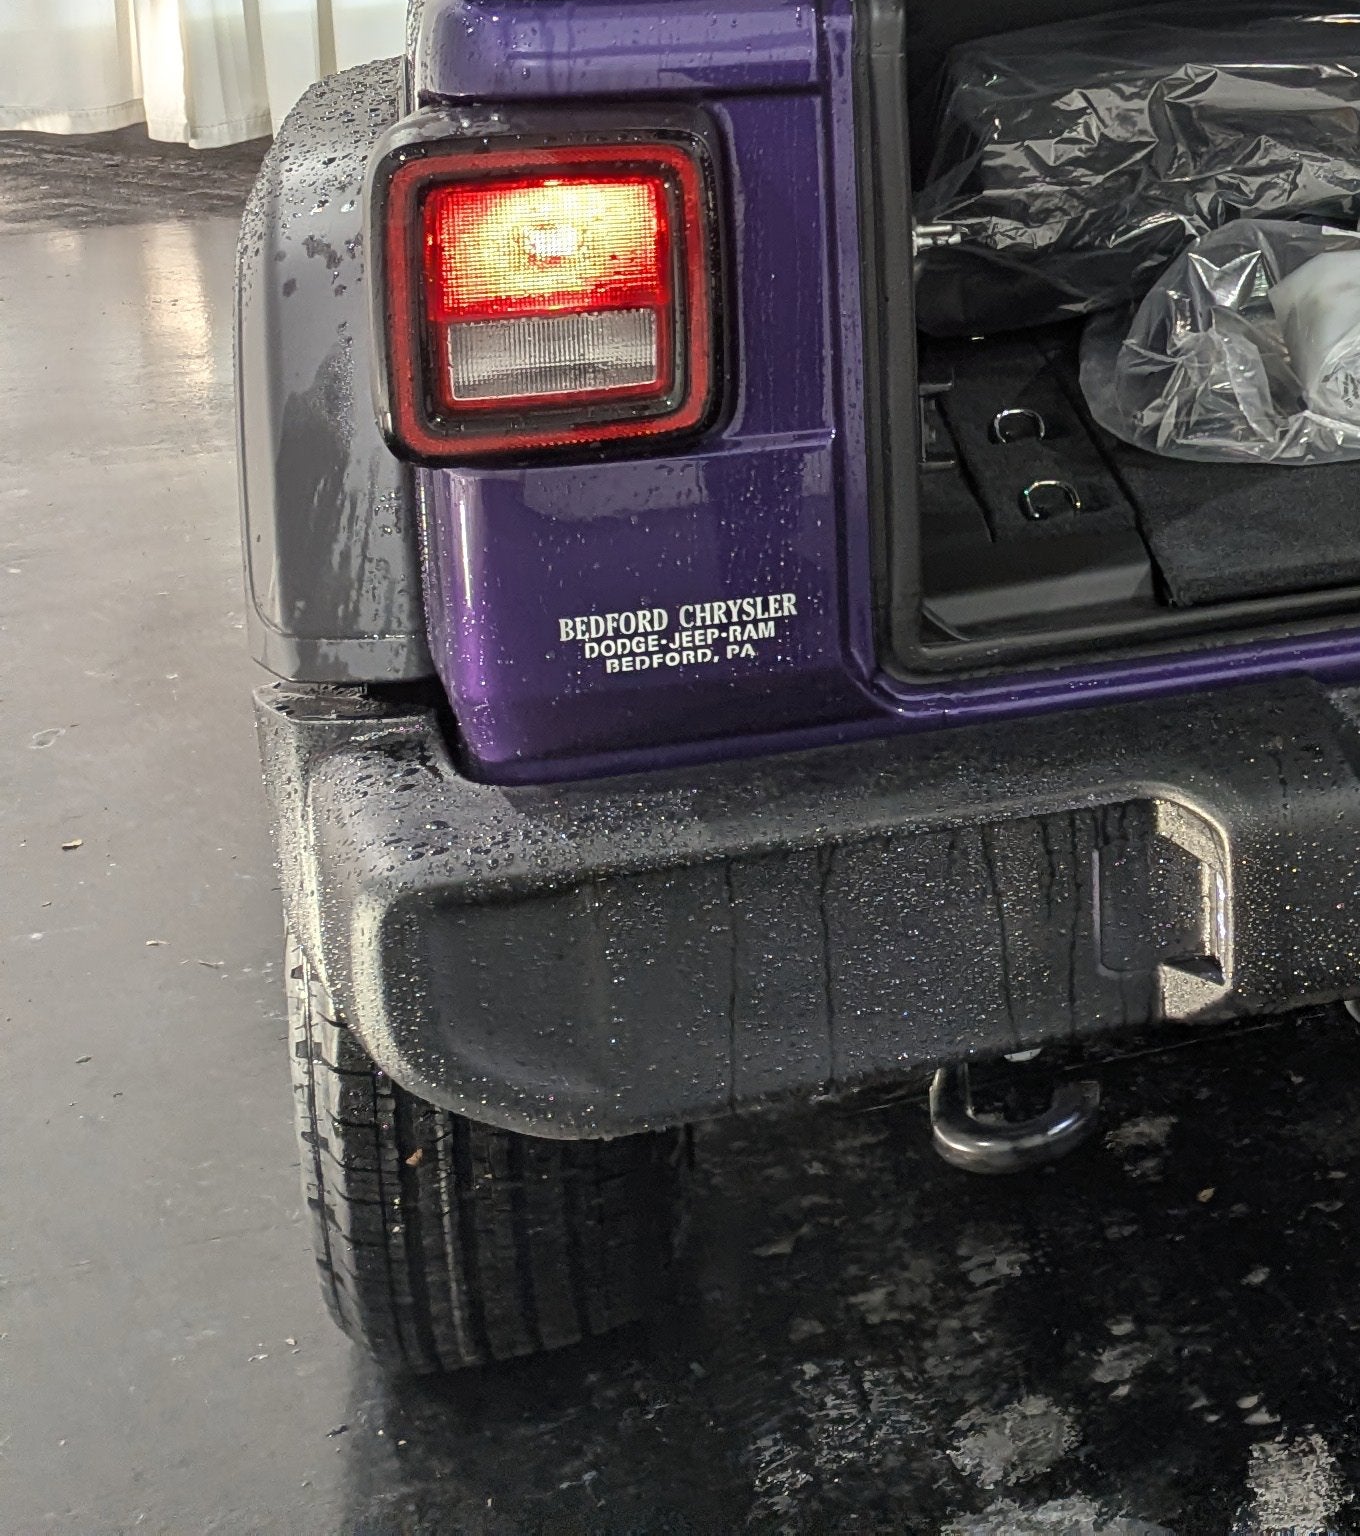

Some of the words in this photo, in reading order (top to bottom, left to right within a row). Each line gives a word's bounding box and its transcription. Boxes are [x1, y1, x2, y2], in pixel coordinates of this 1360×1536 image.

[558, 608, 668, 641] BEDFORD
[679, 593, 798, 628] CHRYSLER
[605, 647, 719, 673] BEDFORD,
[726, 643, 756, 660] PA
